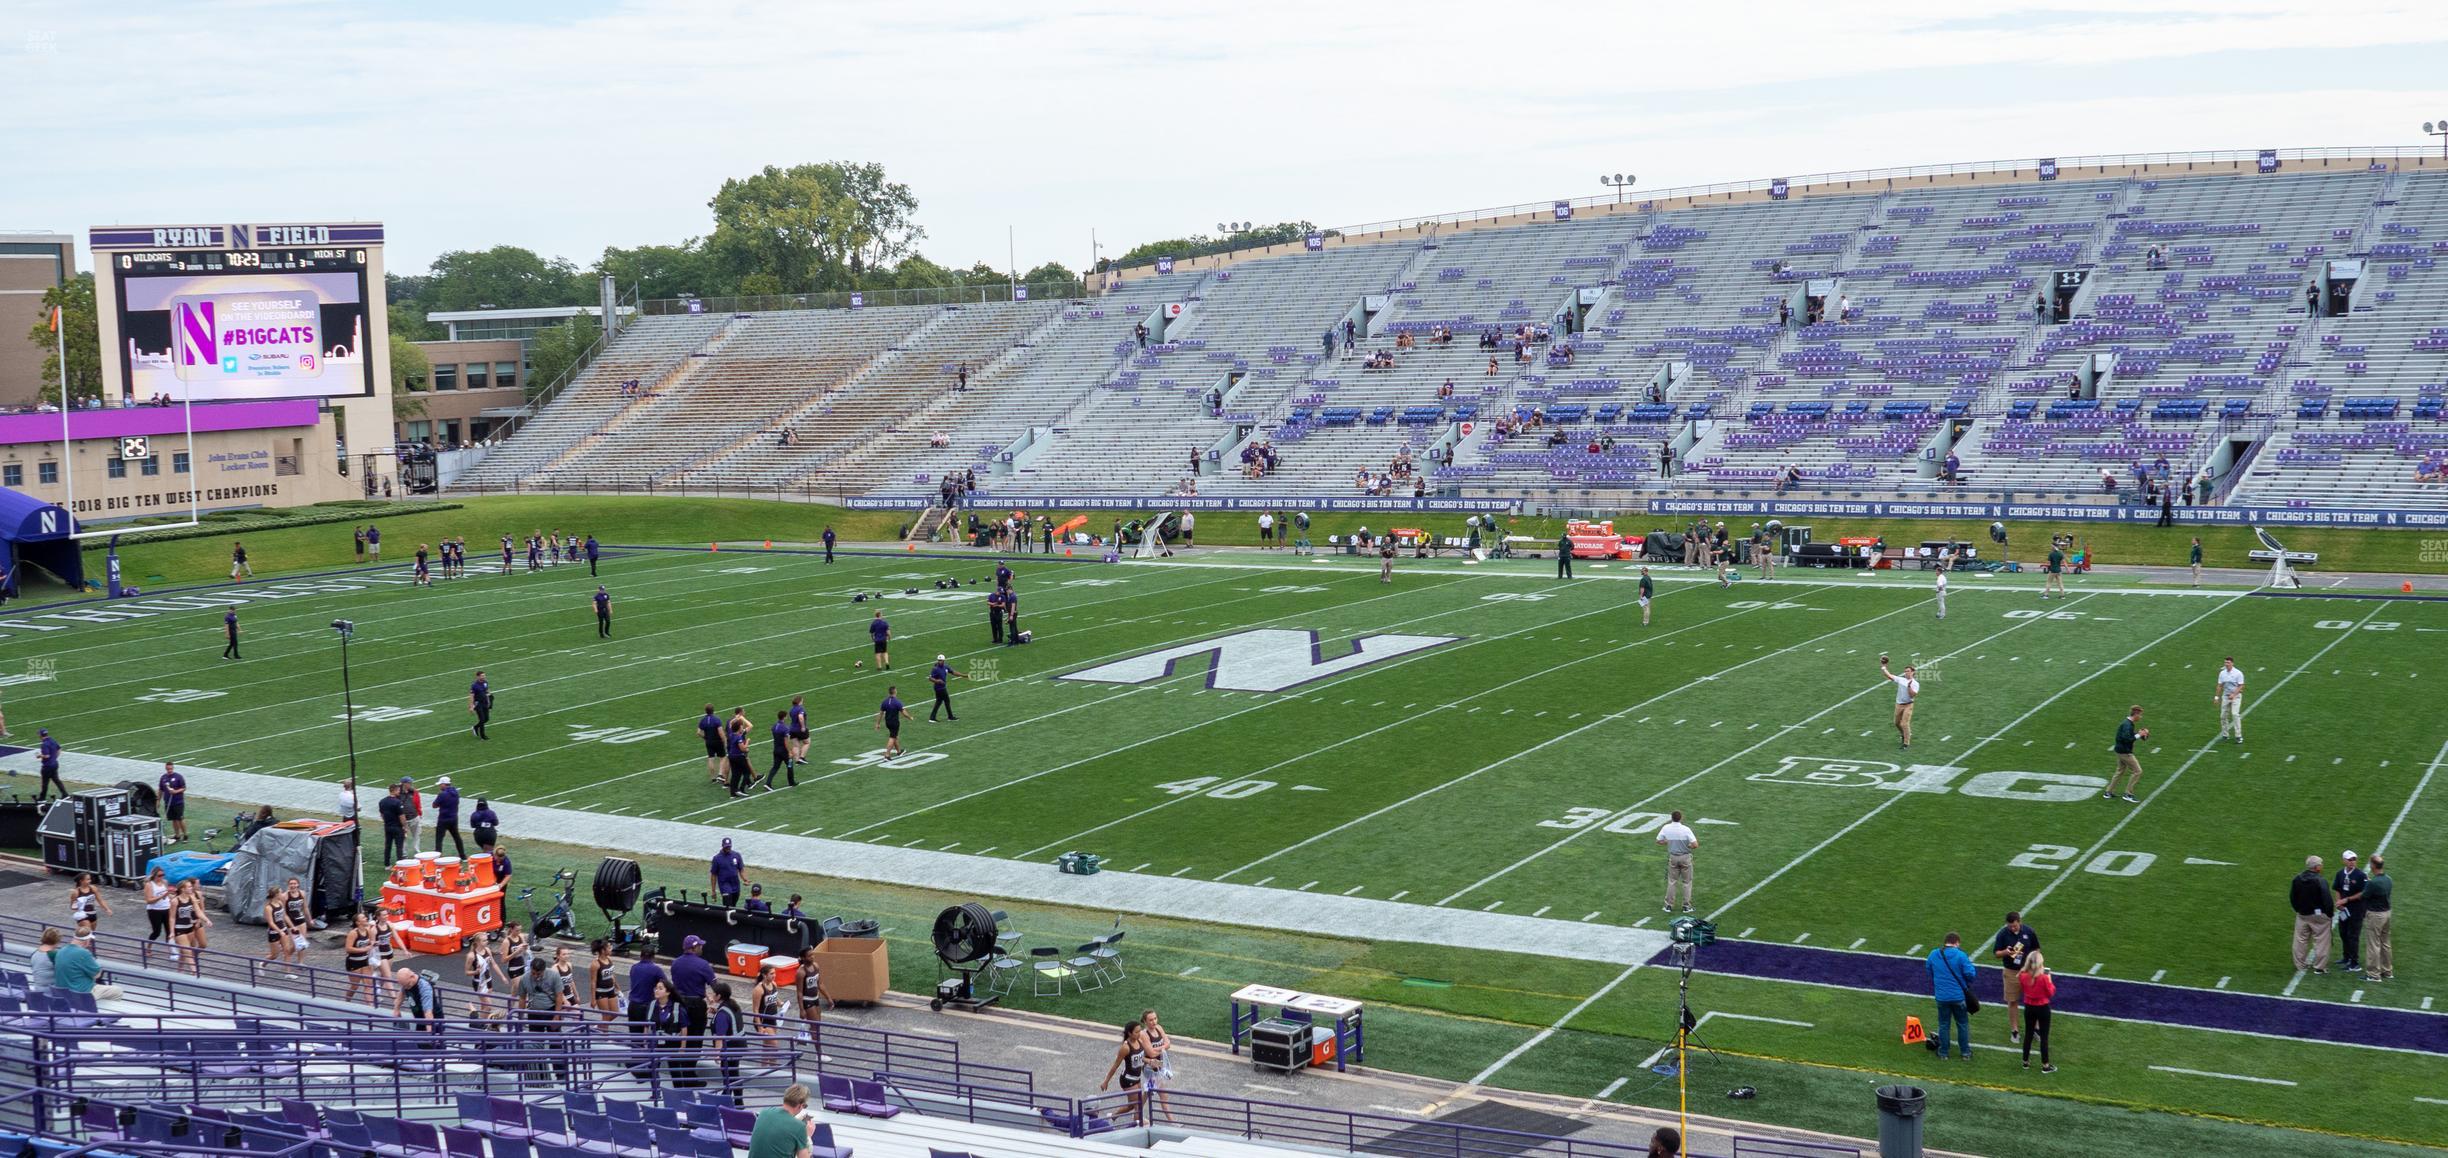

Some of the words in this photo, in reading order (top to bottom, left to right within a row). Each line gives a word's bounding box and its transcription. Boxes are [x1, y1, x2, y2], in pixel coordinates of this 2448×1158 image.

[1773, 185, 1786, 194] 107
[153, 228, 211, 247] RYAN
[269, 226, 330, 246] FIELD
[133, 253, 172, 263] WILDCATS
[1159, 261, 1171, 271] 104
[231, 301, 249, 311] SEE
[249, 299, 302, 310] YOURSELF
[236, 311, 254, 321] THE
[223, 326, 314, 345] #B1GCATS
[124, 439, 146, 456] 25
[208, 454, 226, 463] John
[227, 452, 248, 461] Evans
[250, 450, 268, 460] Club
[221, 463, 246, 472] Locker
[247, 461, 268, 470] Room
[71, 498, 101, 512] 2018
[107, 496, 129, 510] BIG
[135, 493, 160, 507] TEN
[166, 490, 202, 504] WEST
[207, 483, 278, 501] CHAMPIONS
[973, 499, 1004, 507] CHICAGO'S
[1014, 499, 1027, 507] TEN
[1027, 499, 1044, 507] TEAM
[1048, 499, 1055, 507] N
[1059, 499, 1090, 507] CHICAGO'S
[1136, 499, 1143, 507] N
[1147, 499, 1180, 507] CHICAGO'S
[1204, 500, 1223, 508] TEAM
[1227, 499, 1234, 508] N
[1238, 499, 1271, 507] CHICAGO'S
[1297, 500, 1316, 508] TEAM
[1321, 499, 1328, 508] N
[1332, 499, 1366, 508] CHICAGO'S
[1366, 500, 1378, 508] BIG
[1378, 500, 1392, 508] TEN
[1392, 500, 1412, 508] TEAM
[1417, 499, 1424, 509] N
[1429, 500, 1463, 509] CHICAGO'S
[1464, 500, 1475, 509] BIG
[1476, 501, 1491, 509] TEN
[1491, 501, 1510, 509] TEAM
[1652, 501, 1659, 511] N
[1665, 502, 1702, 511] CHCAGO'S
[1703, 502, 1716, 511] BIG
[1717, 503, 1733, 512] TEN
[1733, 503, 1754, 512] TEAM
[1760, 502, 1768, 512] N
[1775, 503, 1813, 513] CHICAGO'S
[1814, 504, 1827, 513] BIG
[1829, 504, 1844, 513] TEN
[1845, 504, 1868, 513] TEAM
[1874, 504, 1882, 515] N
[1889, 505, 1929, 515] CHICAGO'S
[1930, 506, 1945, 515] BIG
[1945, 506, 1961, 515] TEN
[1963, 506, 1985, 515] TEAM
[1993, 505, 2001, 517] N
[2008, 507, 2050, 516] CHICAGO'S
[2051, 508, 2066, 517] BIG
[2067, 508, 2085, 517] TEN
[2085, 508, 2110, 518] TEAM
[2118, 508, 2126, 519] N
[2134, 509, 2178, 519] CHICA'S
[2179, 510, 2195, 519] BIG
[2196, 510, 2214, 520] TEN
[2215, 510, 2241, 520] TEAM
[2249, 510, 2258, 522] N
[2266, 511, 2313, 522] CHICAGO'S
[2314, 512, 2330, 522] BIG
[2331, 512, 2351, 522] TEN
[2352, 513, 2379, 523] TEAM
[41, 511, 57, 534] N
[2387, 513, 2396, 524] N
[111, 560, 120, 572] N
[1153, 776, 1279, 799] 40
[1535, 807, 1672, 834] 30
[2006, 844, 2158, 877] 20
[477, 905, 491, 924] G
[737, 955, 746, 967] G
[1907, 1024, 1921, 1040] 20
[1322, 1041, 1331, 1055] G
